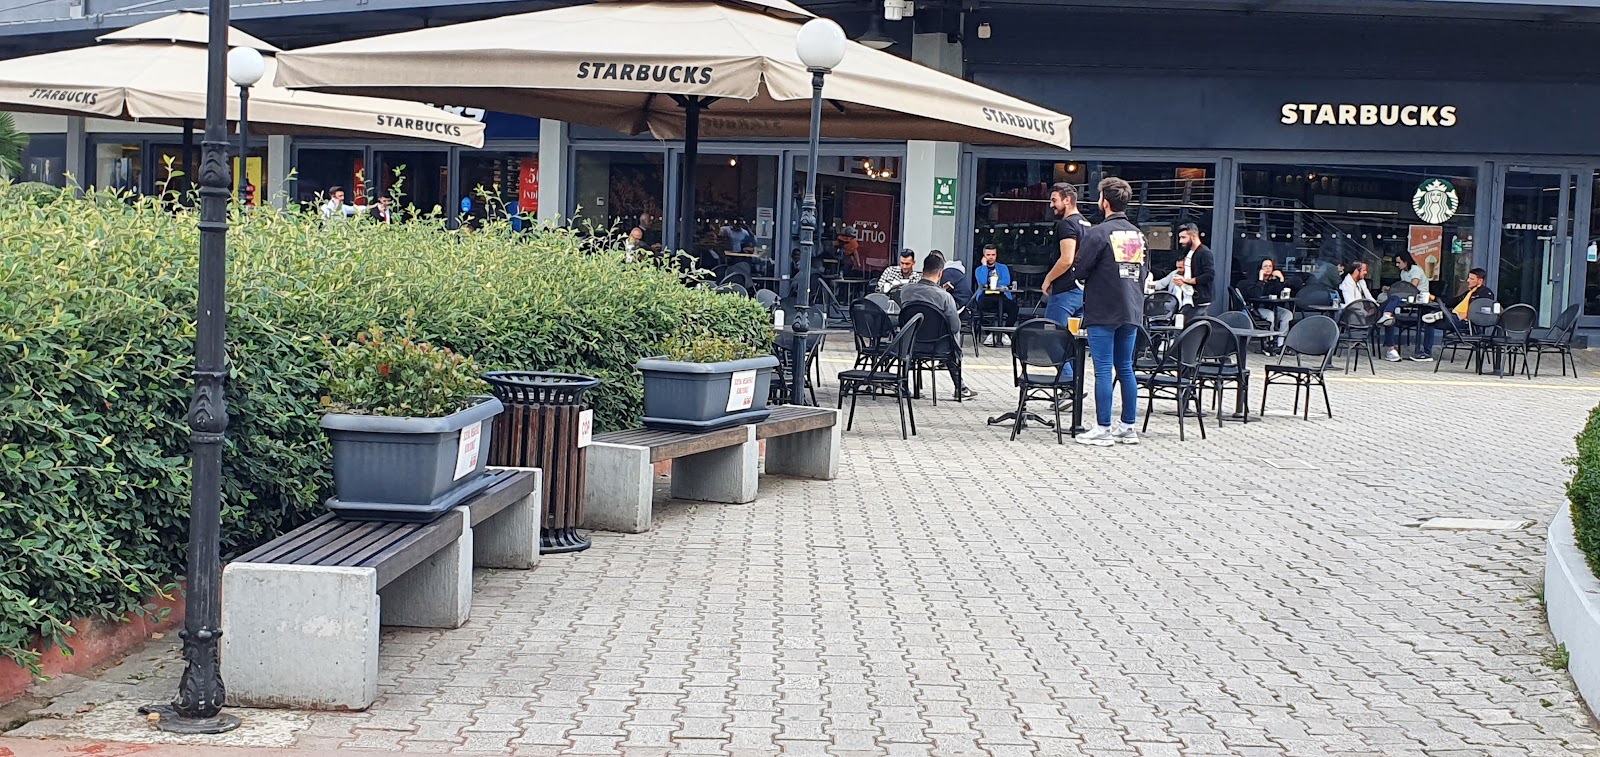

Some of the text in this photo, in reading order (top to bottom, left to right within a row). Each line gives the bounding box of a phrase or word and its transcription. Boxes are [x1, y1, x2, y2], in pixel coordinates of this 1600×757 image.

[577, 61, 713, 84] STARBUCKS
[29, 88, 98, 105] STARBUCKS
[377, 114, 461, 137] STARBUCKS
[982, 107, 1055, 136] STARBUCKS
[1281, 103, 1457, 127] STARBUCKS
[1506, 223, 1553, 231] STARBUCKS
